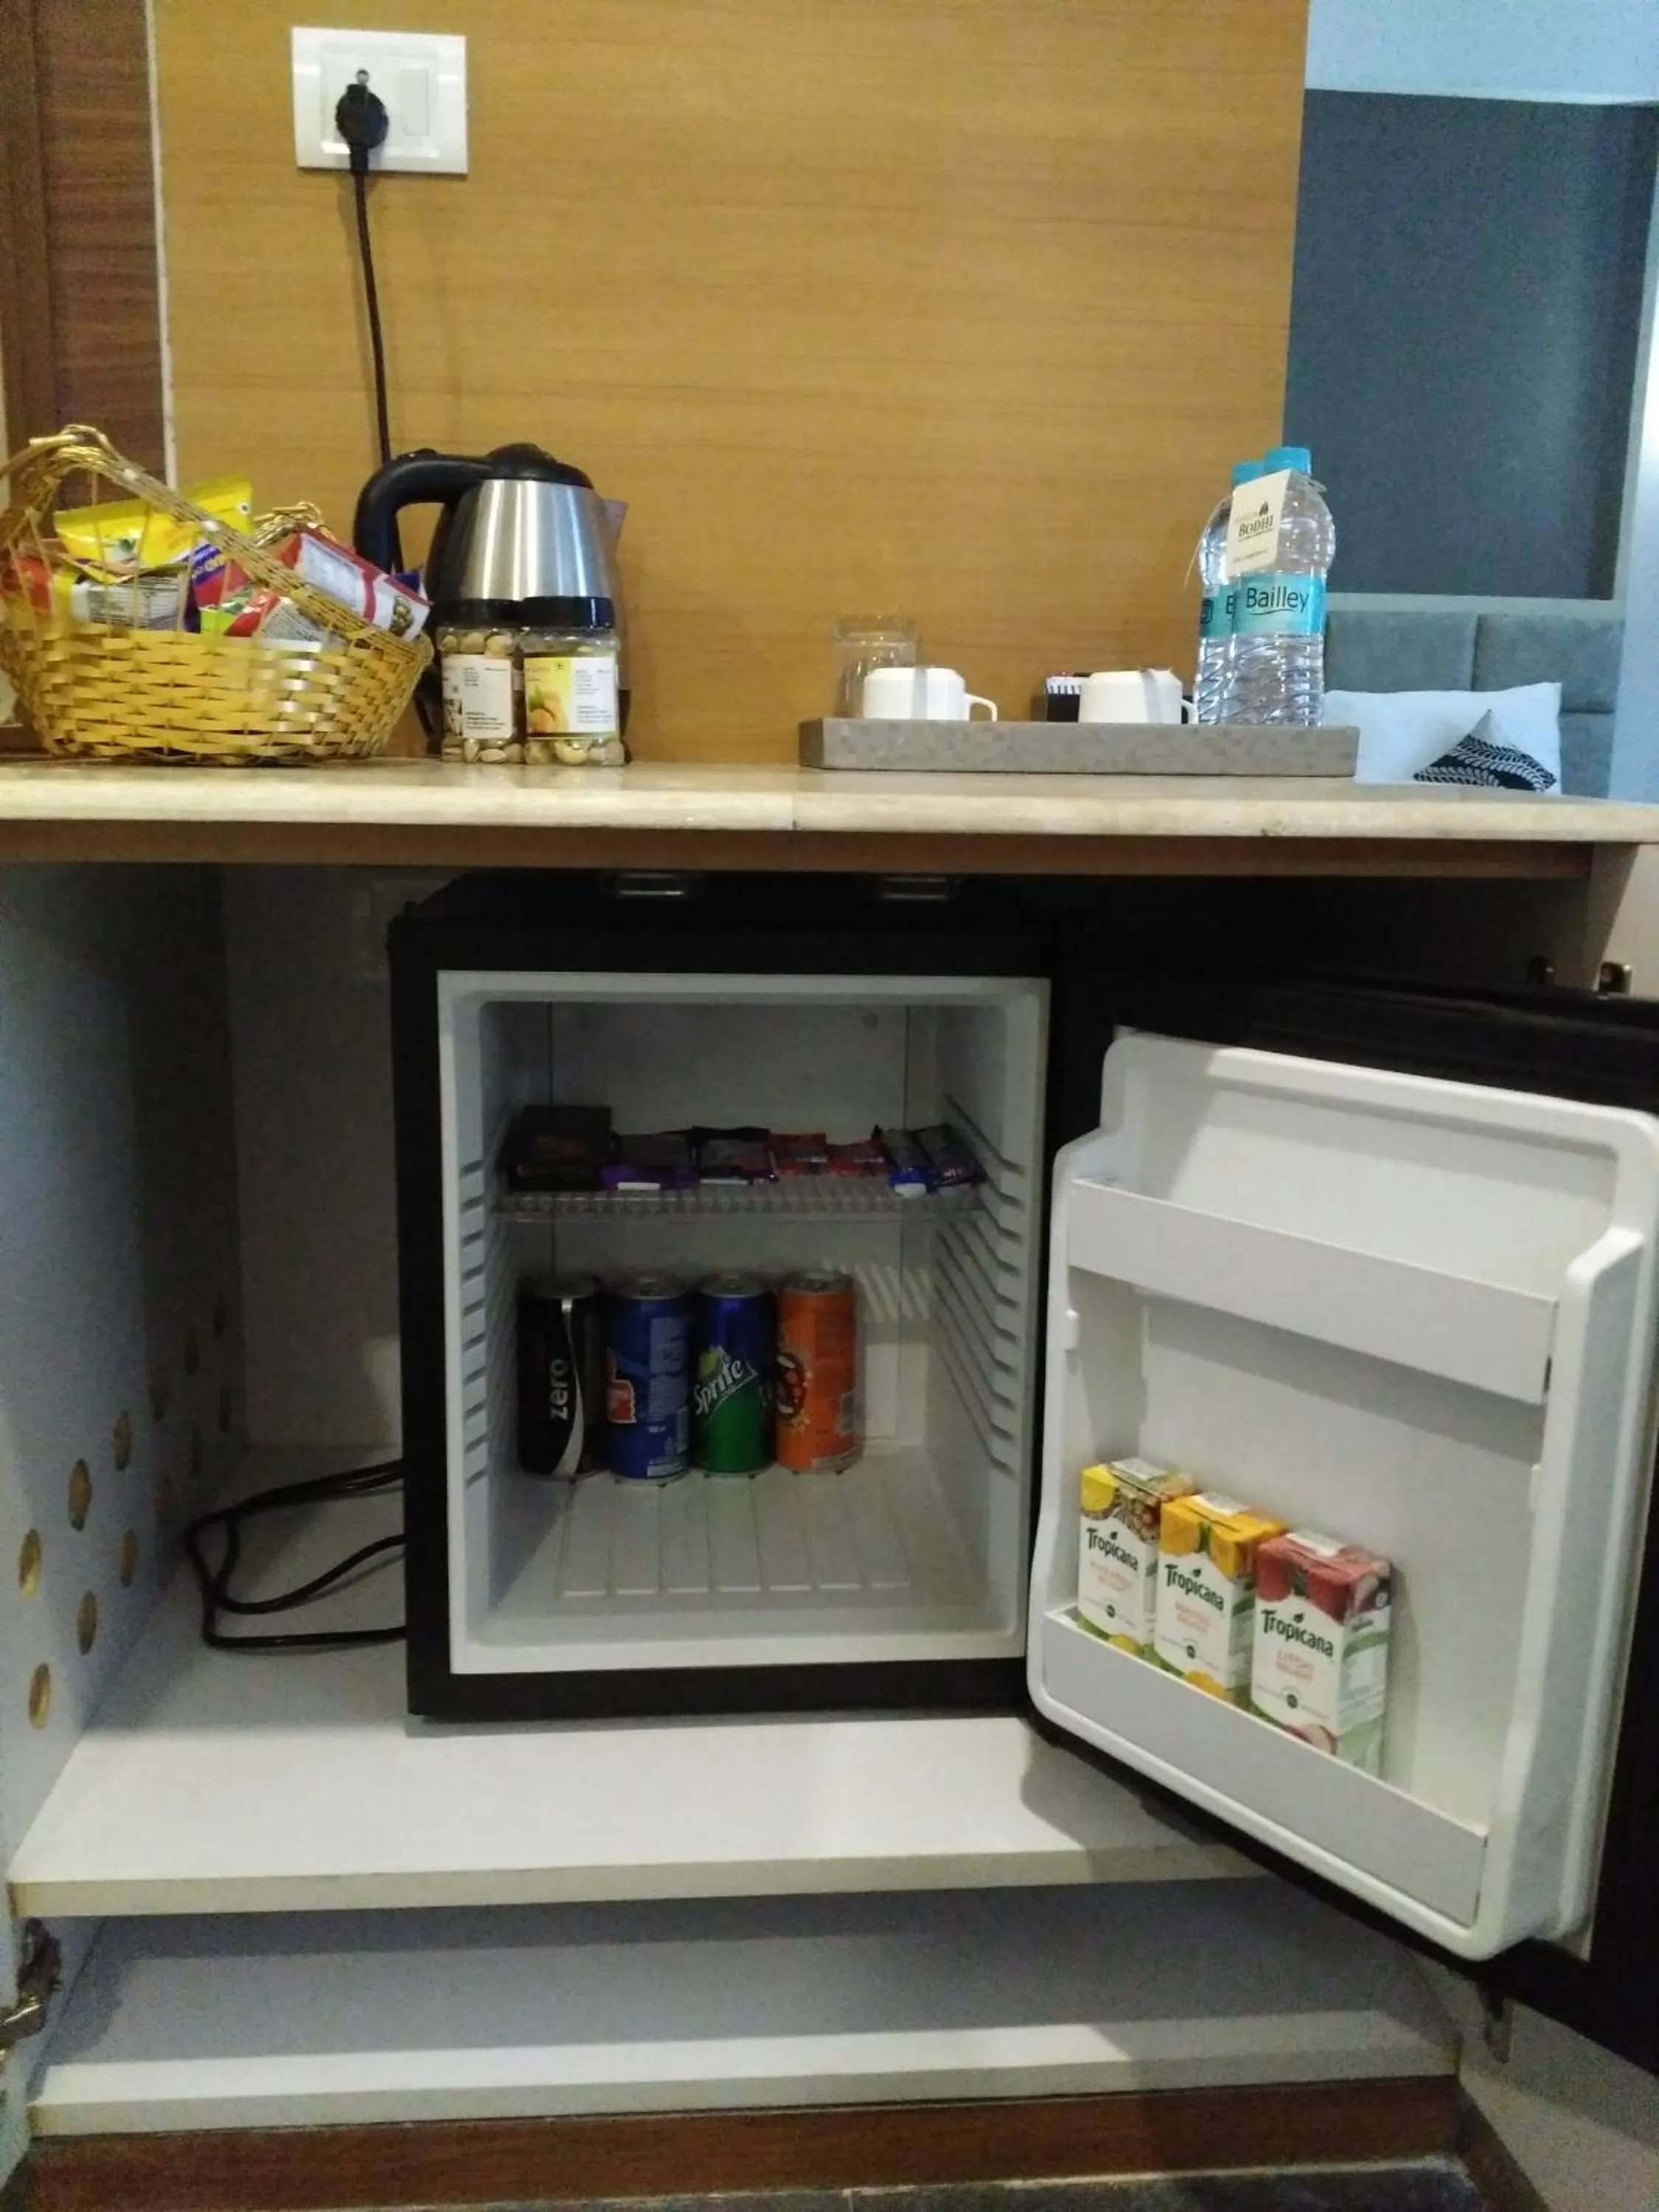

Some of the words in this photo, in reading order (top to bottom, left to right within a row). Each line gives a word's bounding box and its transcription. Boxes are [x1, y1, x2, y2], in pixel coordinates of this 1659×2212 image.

[1246, 587, 1310, 613] Bailley
[550, 1359, 568, 1420] zero
[694, 1360, 742, 1416] Sprite
[1087, 1527, 1138, 1571] Tropicana
[1165, 1563, 1224, 1611] Tropicana
[1261, 1609, 1333, 1658] Tropicana
